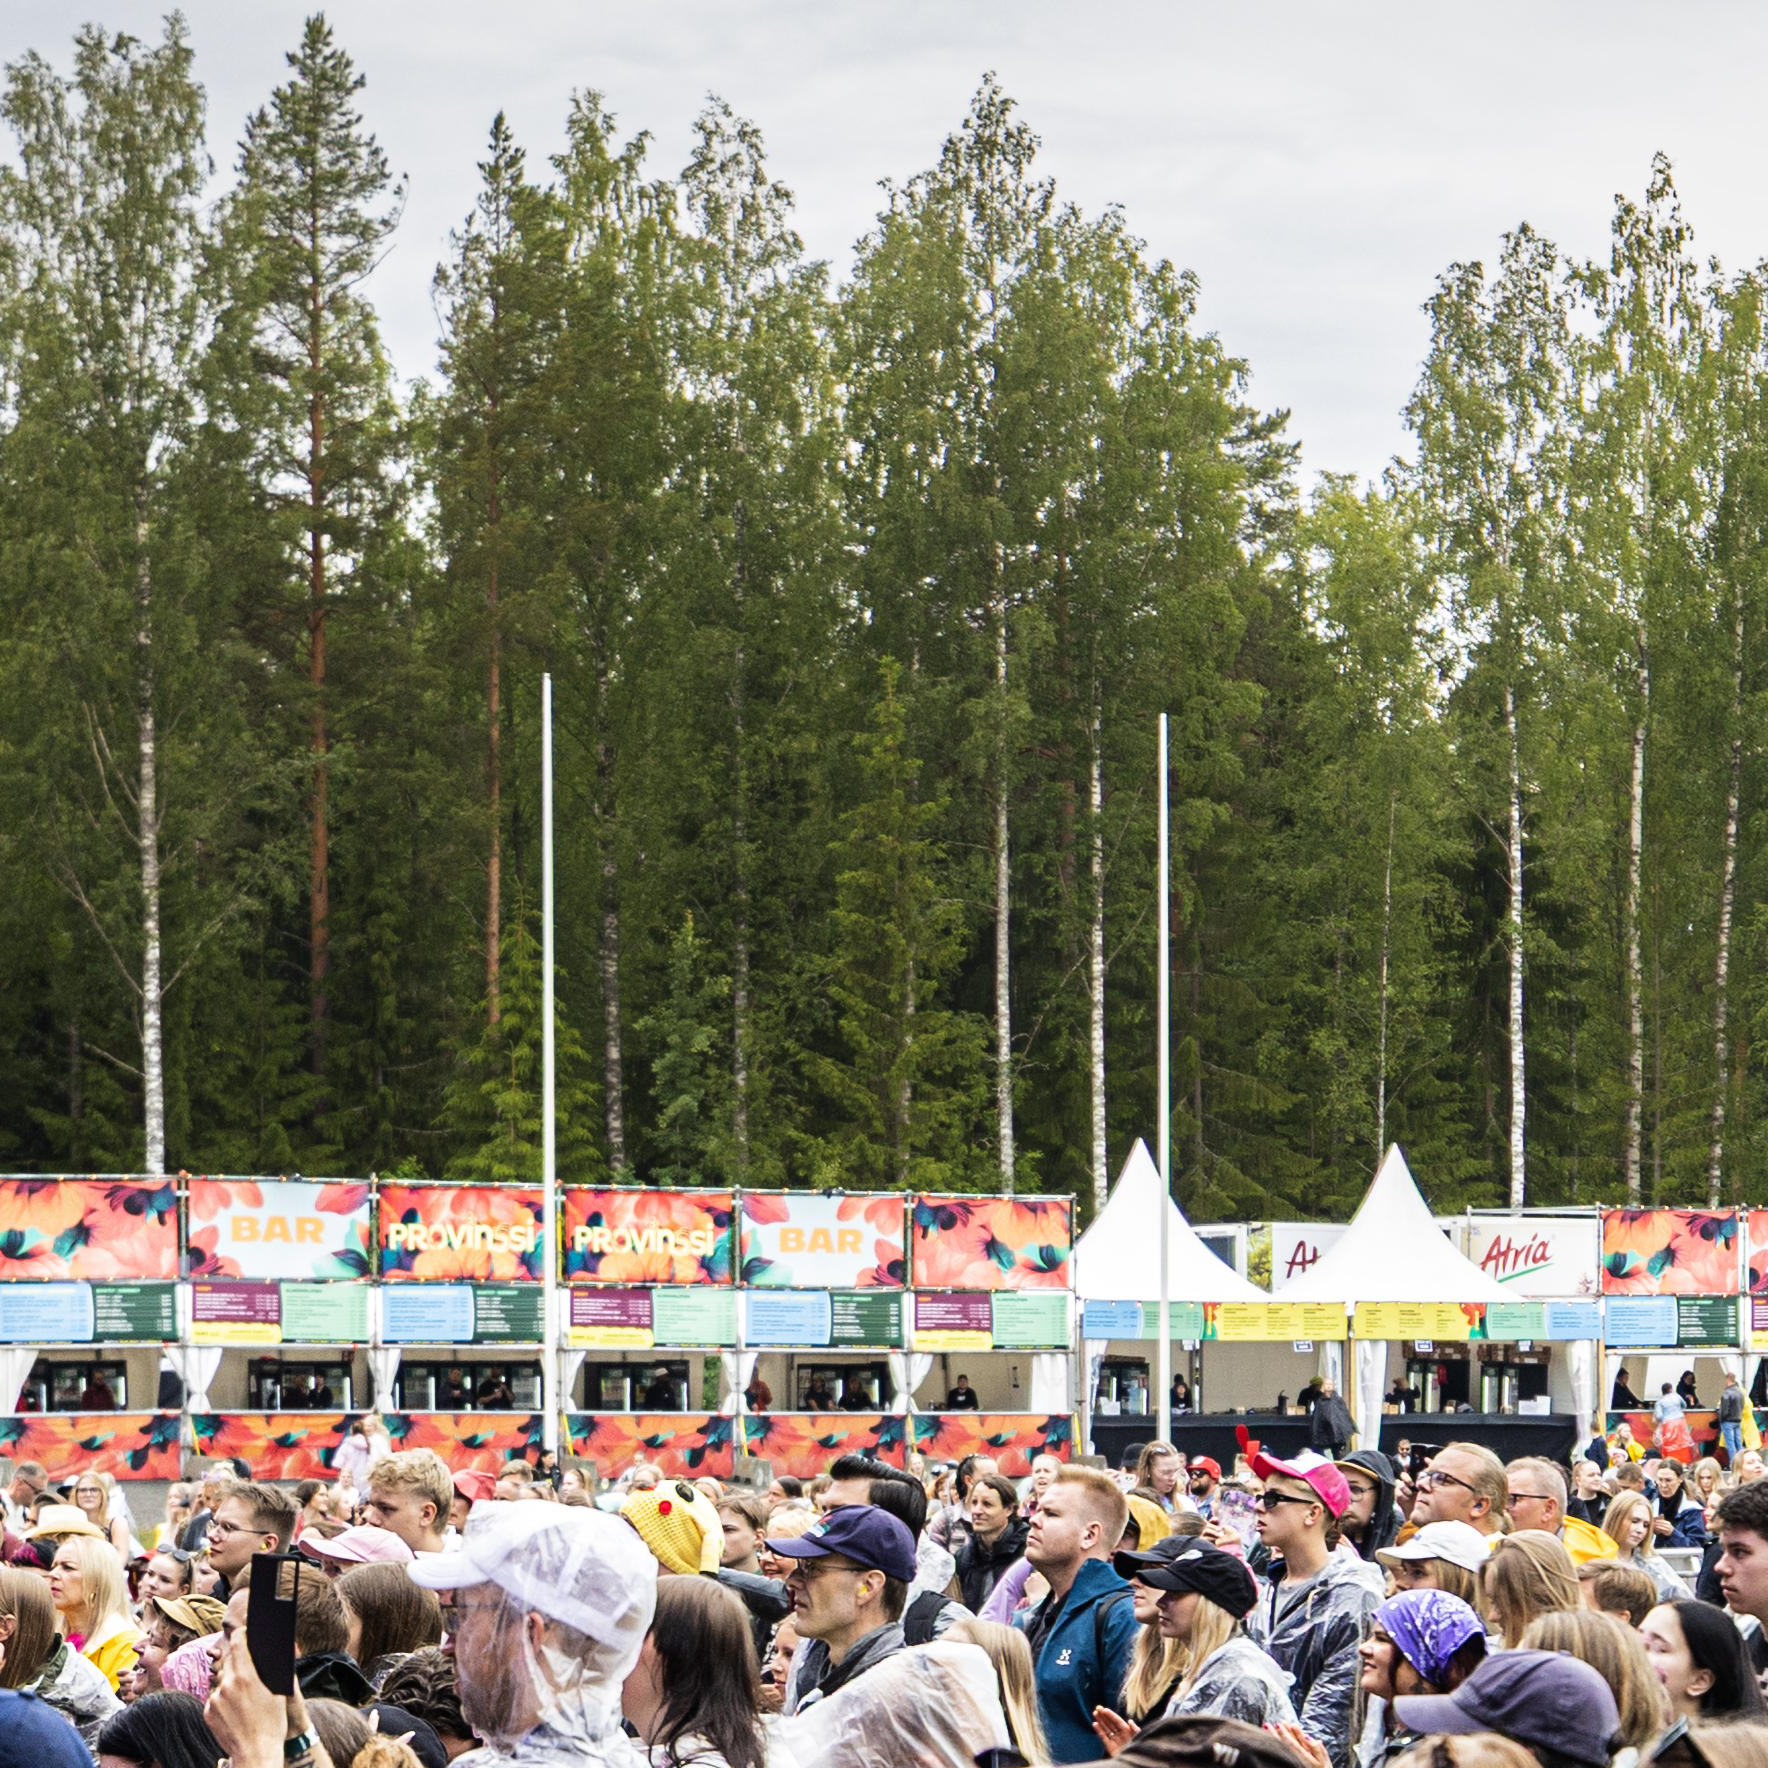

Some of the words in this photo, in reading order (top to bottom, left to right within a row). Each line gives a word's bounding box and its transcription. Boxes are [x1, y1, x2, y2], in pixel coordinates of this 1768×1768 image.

[230, 1215, 326, 1244] BAR
[778, 1227, 864, 1255] BAR
[1479, 1233, 1554, 1279] Atria
